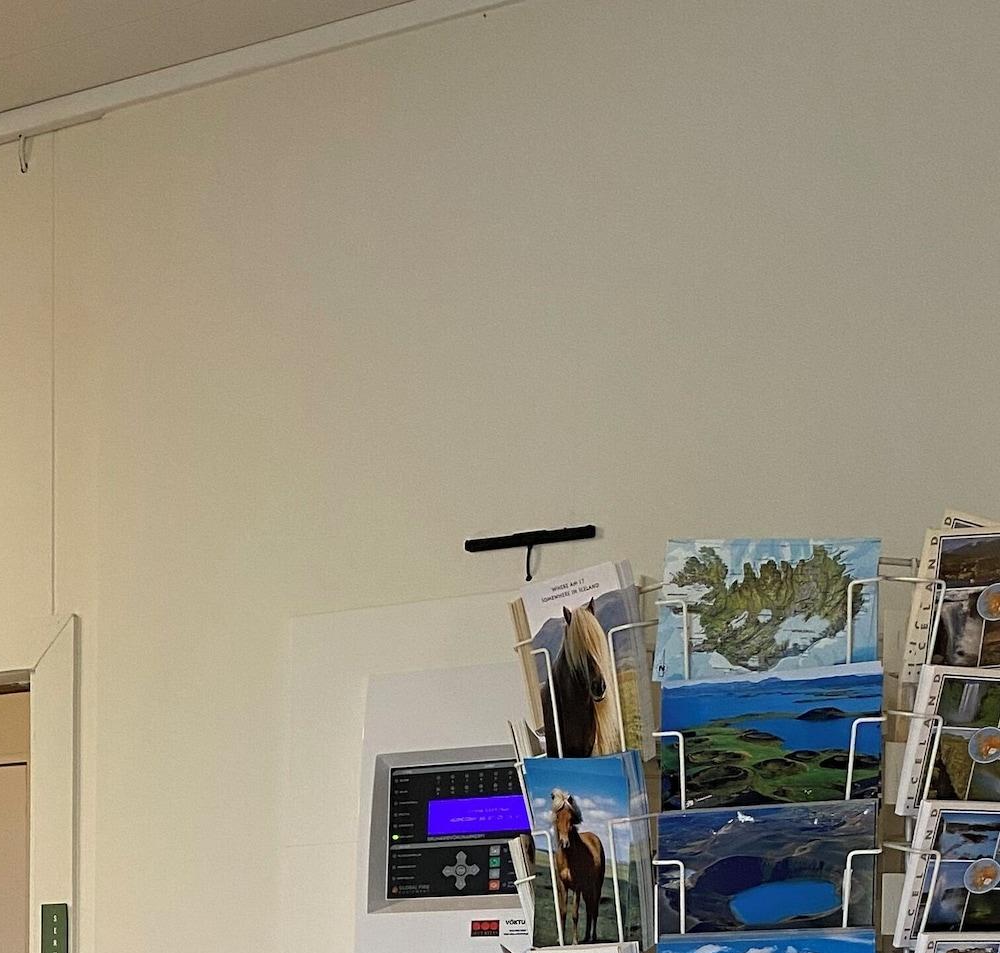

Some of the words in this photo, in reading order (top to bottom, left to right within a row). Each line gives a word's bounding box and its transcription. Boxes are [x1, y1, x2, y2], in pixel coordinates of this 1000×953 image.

[578, 582, 600, 593] ICELAND
[906, 674, 941, 800] ICELAND
[903, 808, 939, 931] ICELAND
